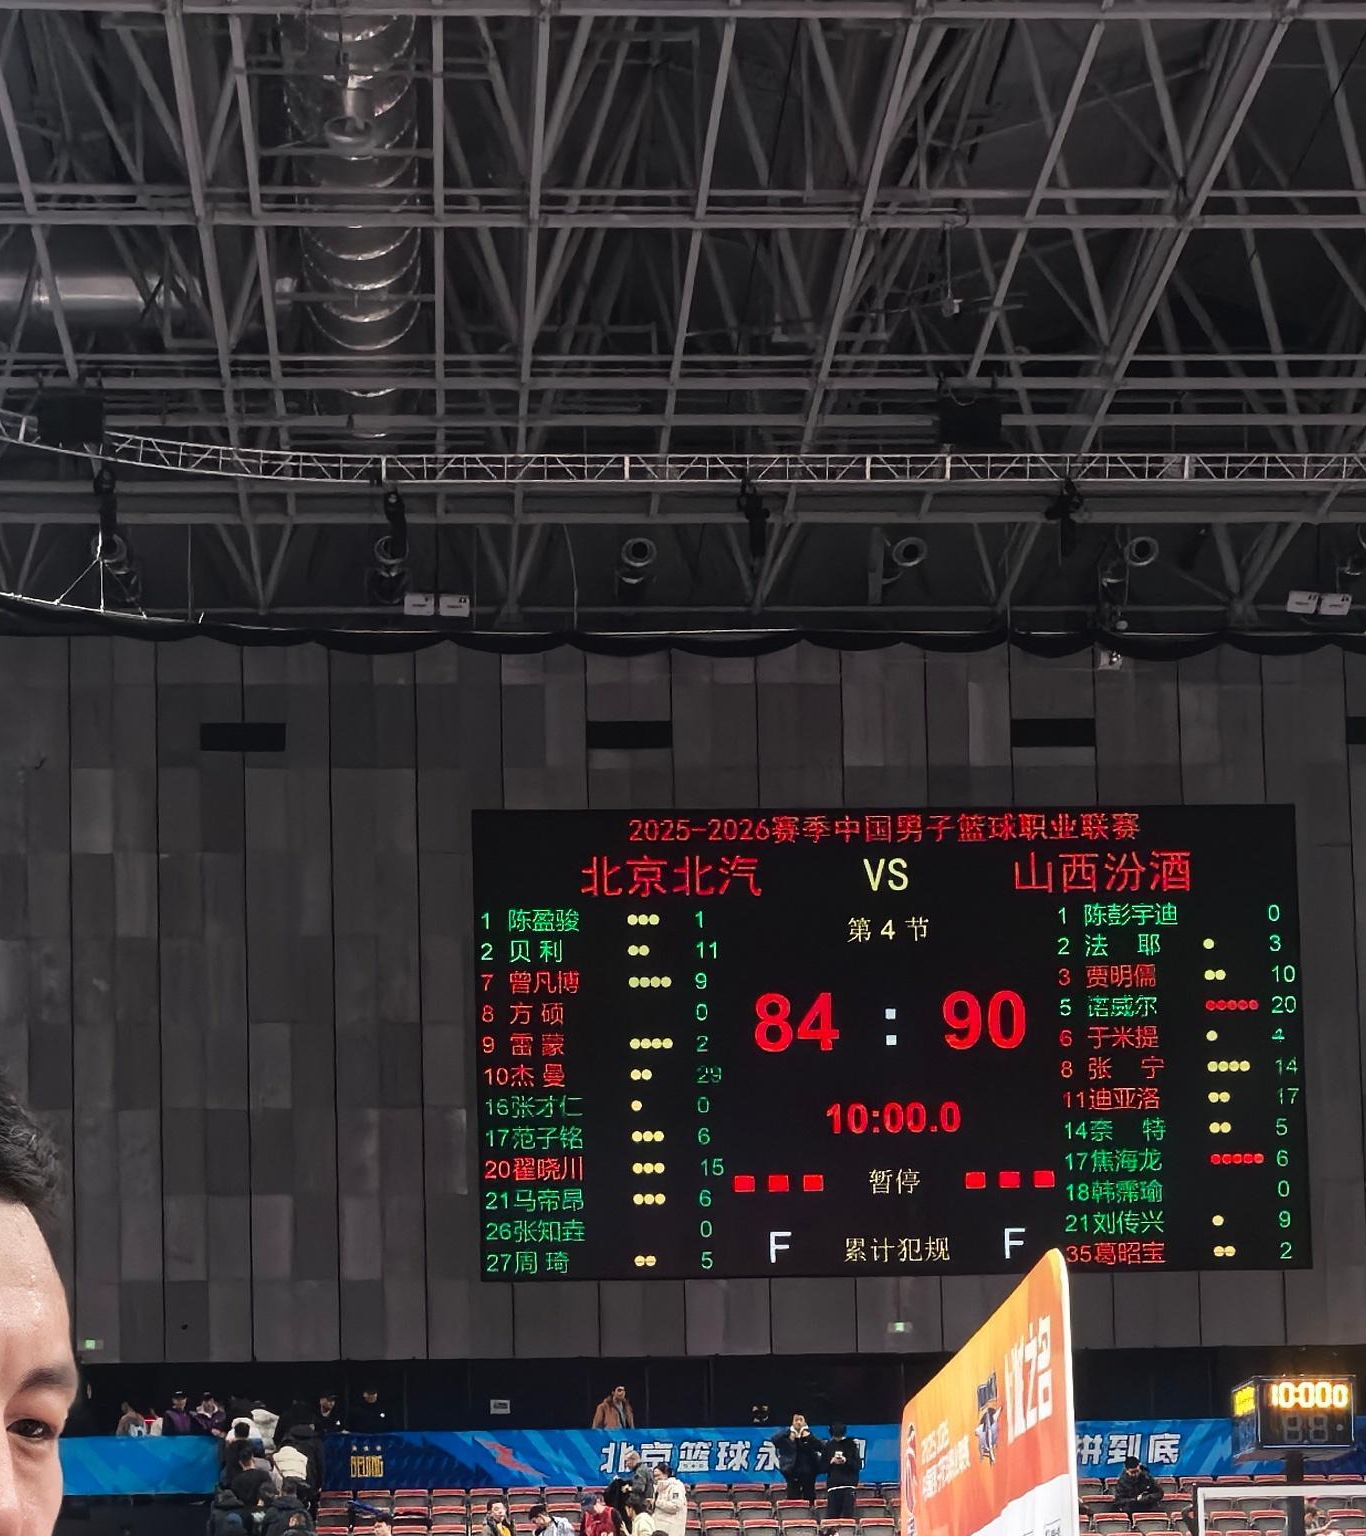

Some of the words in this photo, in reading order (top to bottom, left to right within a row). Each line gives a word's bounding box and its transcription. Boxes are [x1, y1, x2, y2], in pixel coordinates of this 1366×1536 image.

[629, 813, 1139, 843] 2025-2026赛季中国男子篮球职业联赛
[581, 855, 762, 897] 北京北汽
[863, 858, 908, 891] VS
[1014, 851, 1190, 893] 山西汾酒
[480, 912, 491, 930] 1
[508, 908, 580, 933] 陈盈骏
[694, 910, 704, 929] 1
[1057, 906, 1067, 925] 1
[1083, 901, 1179, 927] 陈彭宇迪
[1267, 904, 1281, 922] 0
[480, 942, 494, 961] 2
[695, 941, 718, 960] 11
[1057, 937, 1071, 956] 2
[1269, 934, 1282, 952] 3
[480, 973, 494, 992] 7
[508, 970, 580, 995] 曾凡博
[694, 972, 708, 990] 9
[1058, 968, 1071, 986] 3
[1085, 963, 1157, 989] 贾明儒
[1271, 964, 1296, 983] 10
[481, 1005, 495, 1023] 8
[695, 1003, 708, 1021] 0
[1059, 998, 1072, 1017] 5
[1271, 995, 1297, 1014] 20
[754, 992, 840, 1052] 84
[942, 989, 1026, 1050] 90
[482, 1036, 495, 1054] 9
[695, 1035, 709, 1053] 2
[1059, 1029, 1073, 1048] 6
[1087, 1024, 1160, 1050] 于米提
[1060, 1060, 1074, 1079] 8
[1274, 1056, 1299, 1075] 14
[510, 1095, 584, 1119] 张才仁
[697, 1096, 710, 1114] 0
[1088, 1087, 1161, 1111] 迪亚洛
[1277, 1087, 1300, 1105] 17
[826, 1101, 961, 1134] 10:00.0
[1275, 1118, 1288, 1136] 5
[511, 1125, 584, 1151] 范子铭
[697, 1127, 711, 1146] 6
[512, 1156, 584, 1182] 翟晓川
[700, 1158, 725, 1176] 15
[1276, 1149, 1289, 1168] 6
[869, 1169, 920, 1194] 暂停
[1277, 1180, 1290, 1198] 0
[513, 1188, 585, 1213] 马帝昂
[698, 1189, 713, 1207] 6
[699, 1220, 713, 1238] 0
[1092, 1210, 1165, 1235] 刘传兴
[1278, 1210, 1292, 1228] 9
[770, 1232, 792, 1263] F
[844, 1236, 950, 1262] 累计犯规
[1004, 1228, 1025, 1259] F
[1279, 1241, 1293, 1260] 2
[701, 1251, 714, 1270] 5
